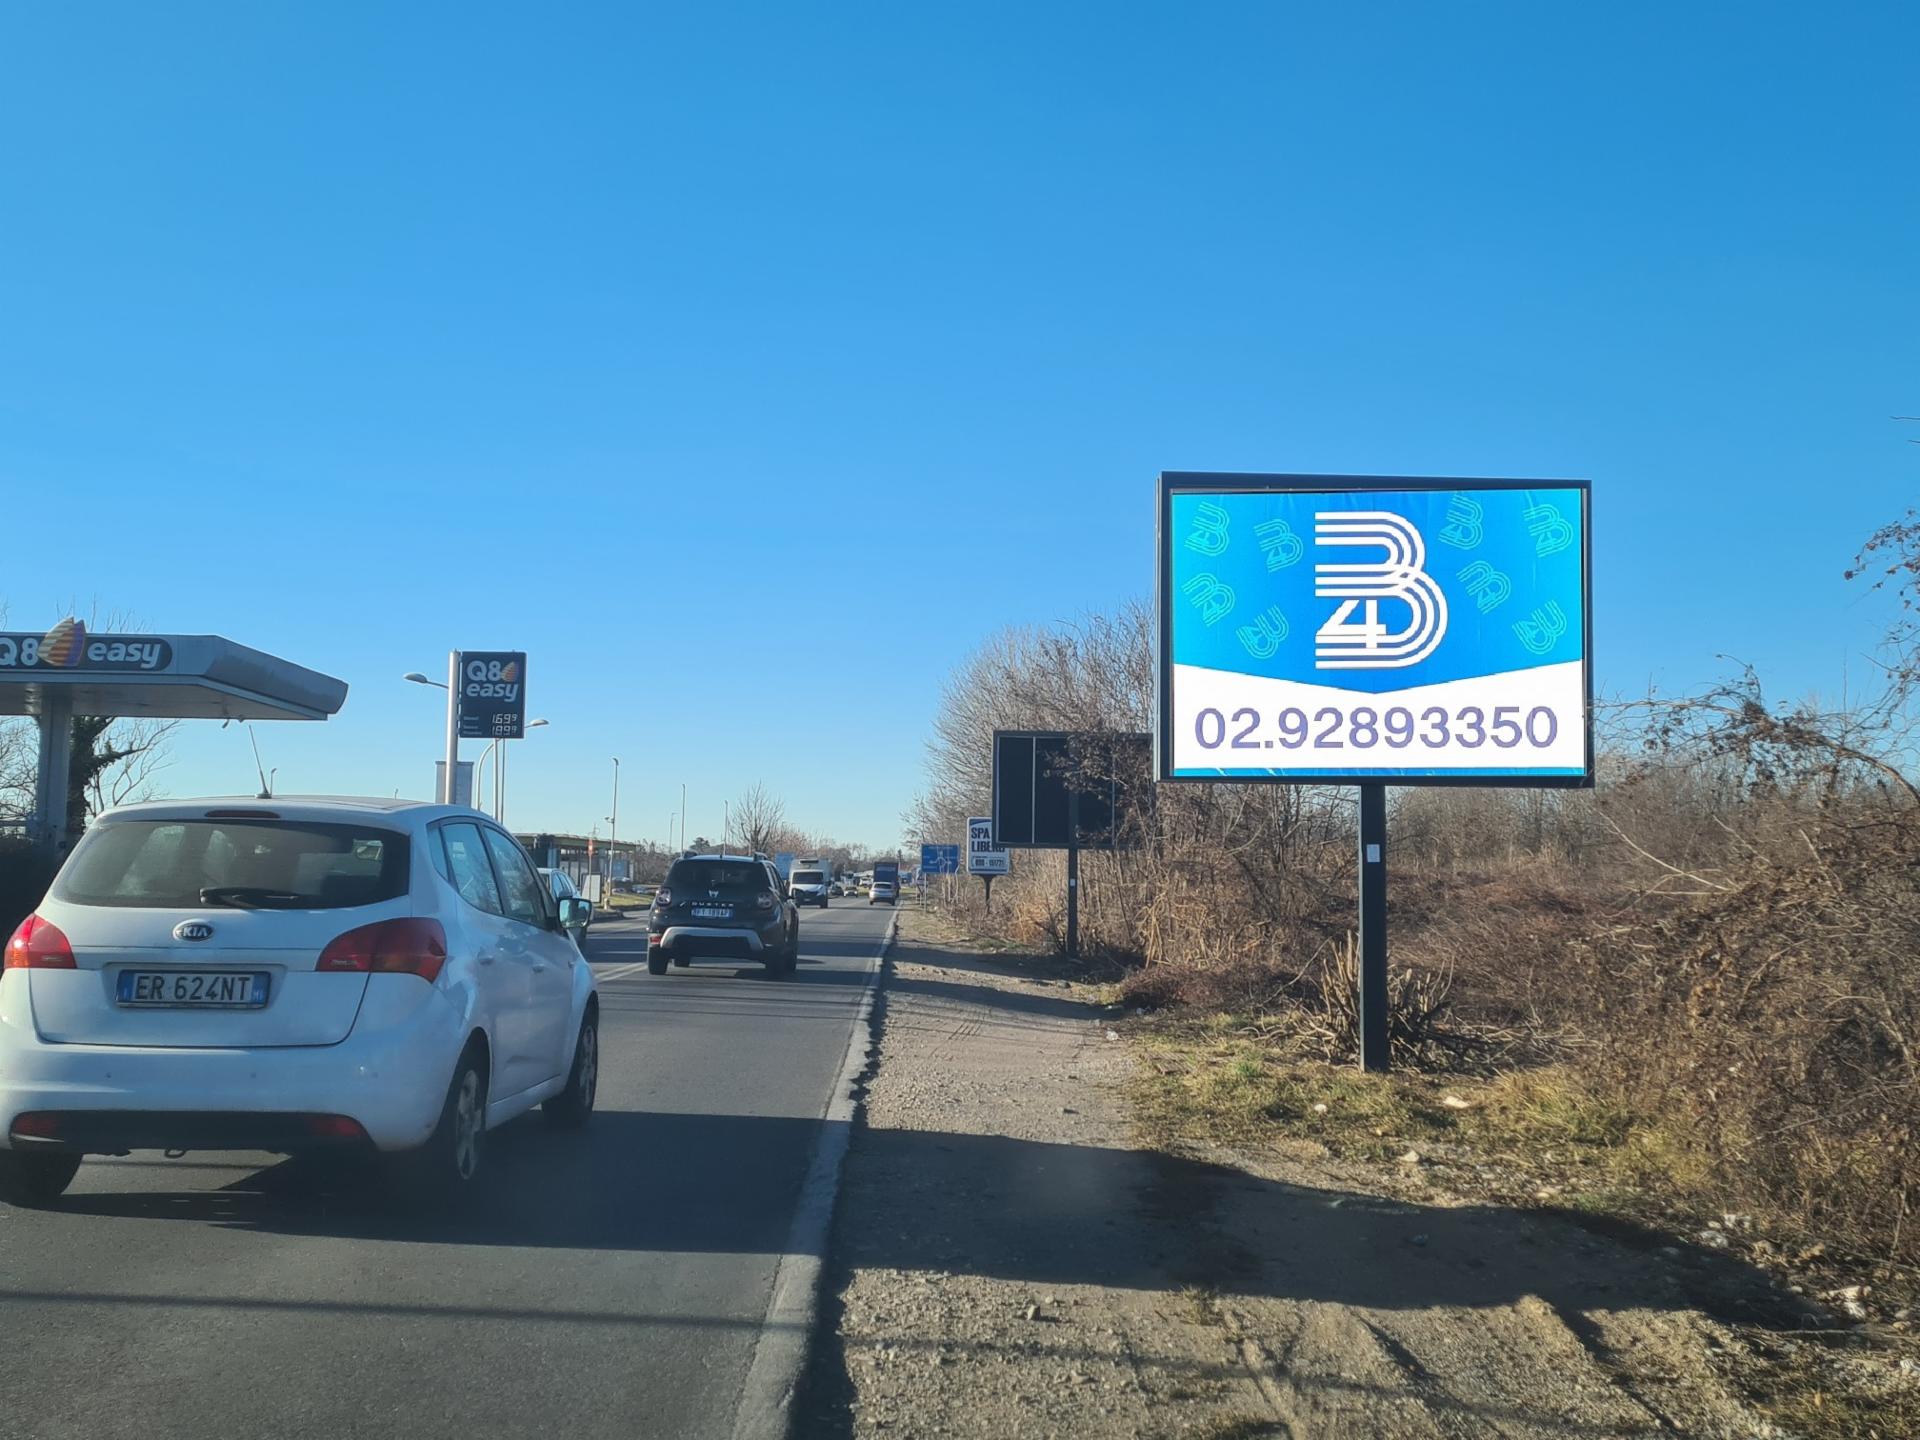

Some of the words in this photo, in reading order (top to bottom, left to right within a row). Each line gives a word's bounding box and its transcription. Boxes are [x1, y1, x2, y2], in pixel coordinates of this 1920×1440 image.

[87, 639, 161, 669] easy
[467, 660, 501, 682] Q8
[466, 683, 518, 702] easy
[1195, 705, 1558, 749] 02.92893350
[970, 827, 991, 839] SPA
[182, 926, 209, 937] KIA
[135, 976, 165, 999] ER
[174, 976, 250, 1001] 624NT
